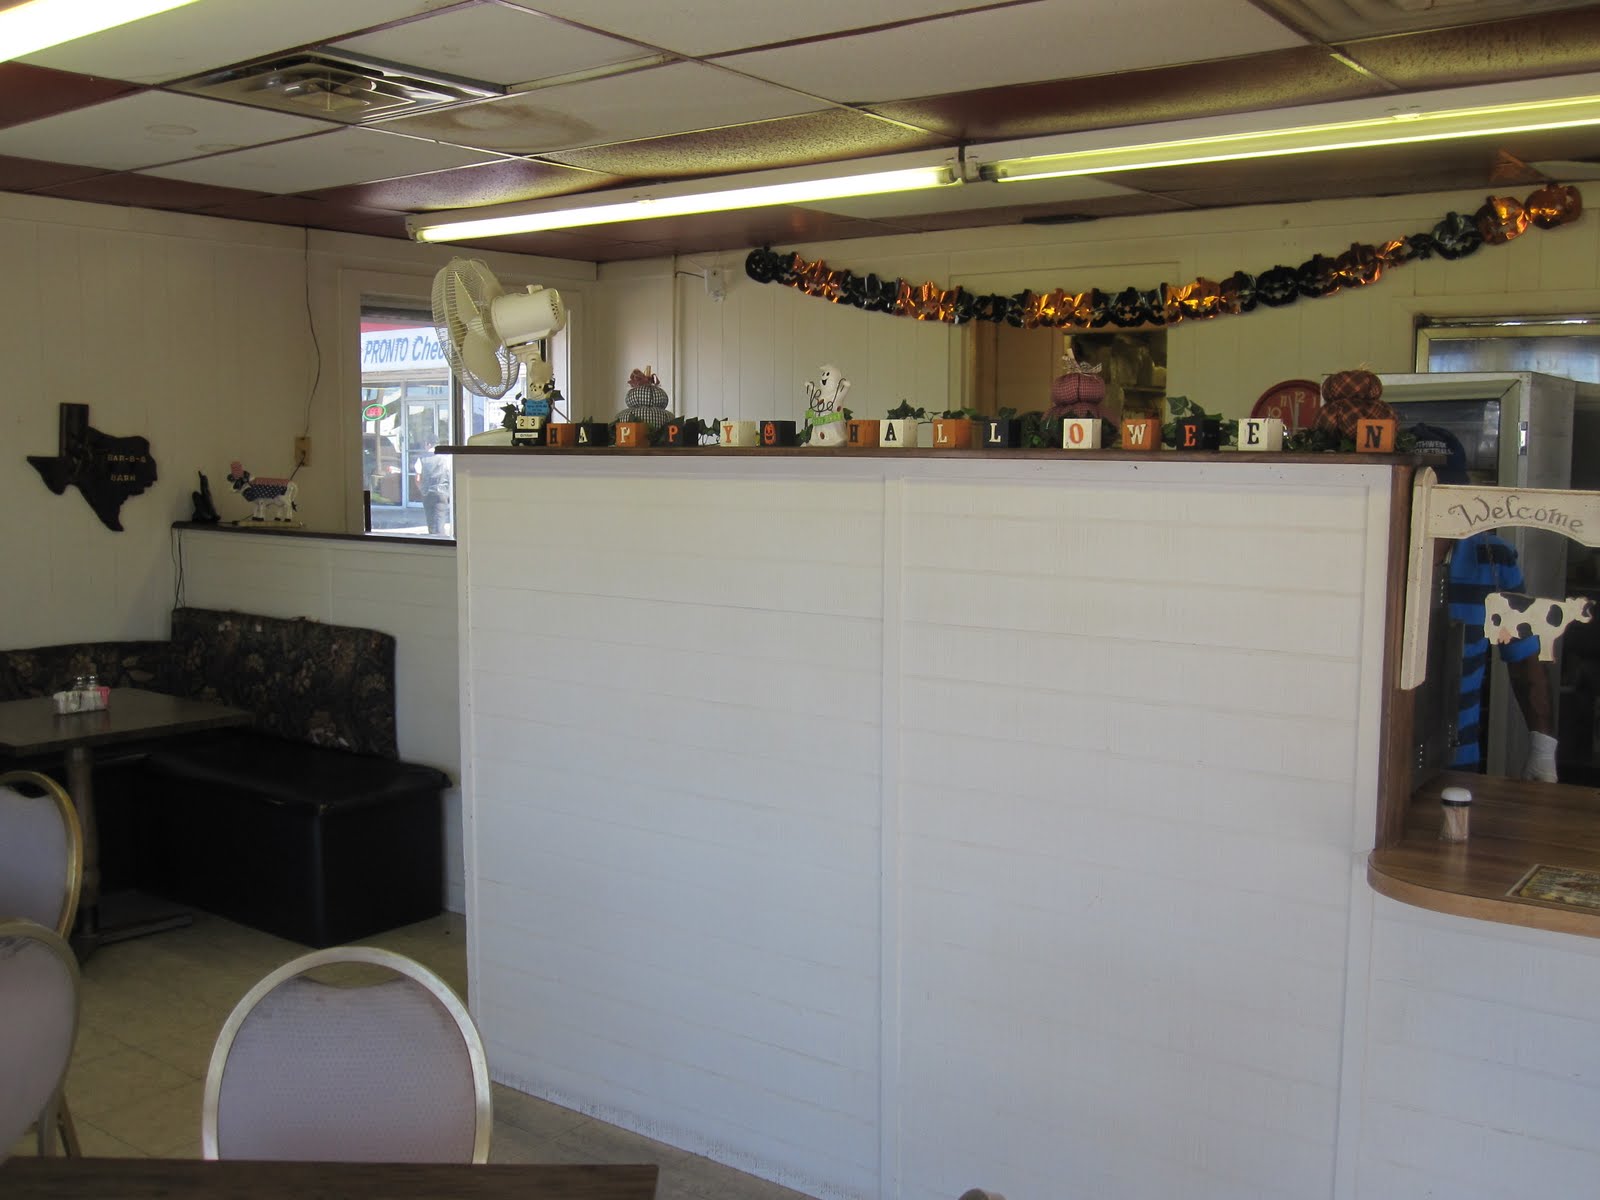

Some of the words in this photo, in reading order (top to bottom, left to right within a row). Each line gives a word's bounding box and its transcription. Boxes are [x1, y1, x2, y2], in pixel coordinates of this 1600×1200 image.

[364, 337, 408, 364] PRONTO
[412, 335, 446, 361] Chec
[1448, 495, 1584, 534] Welcome
